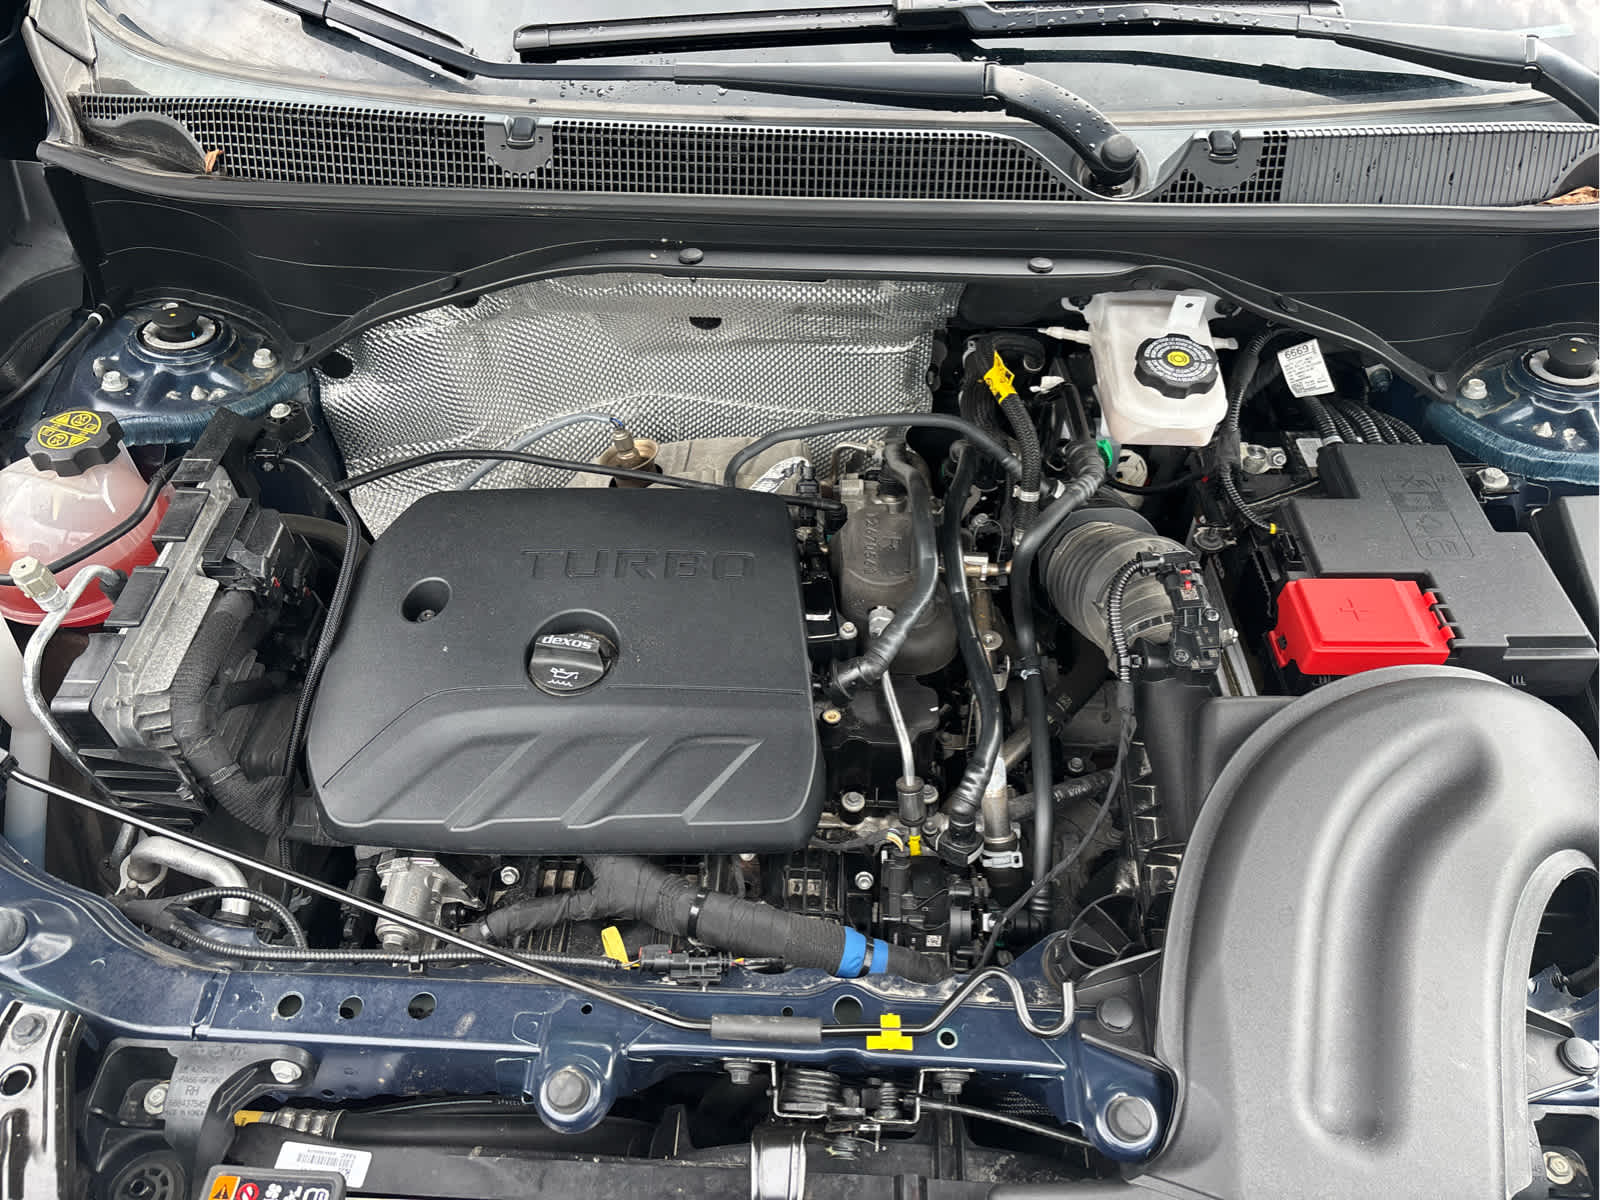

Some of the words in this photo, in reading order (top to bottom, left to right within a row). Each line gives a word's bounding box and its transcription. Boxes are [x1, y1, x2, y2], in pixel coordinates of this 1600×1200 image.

[1285, 344, 1309, 359] 6669
[521, 549, 755, 580] TURBO
[541, 635, 593, 650] dexos
[185, 1085, 199, 1095] RH
